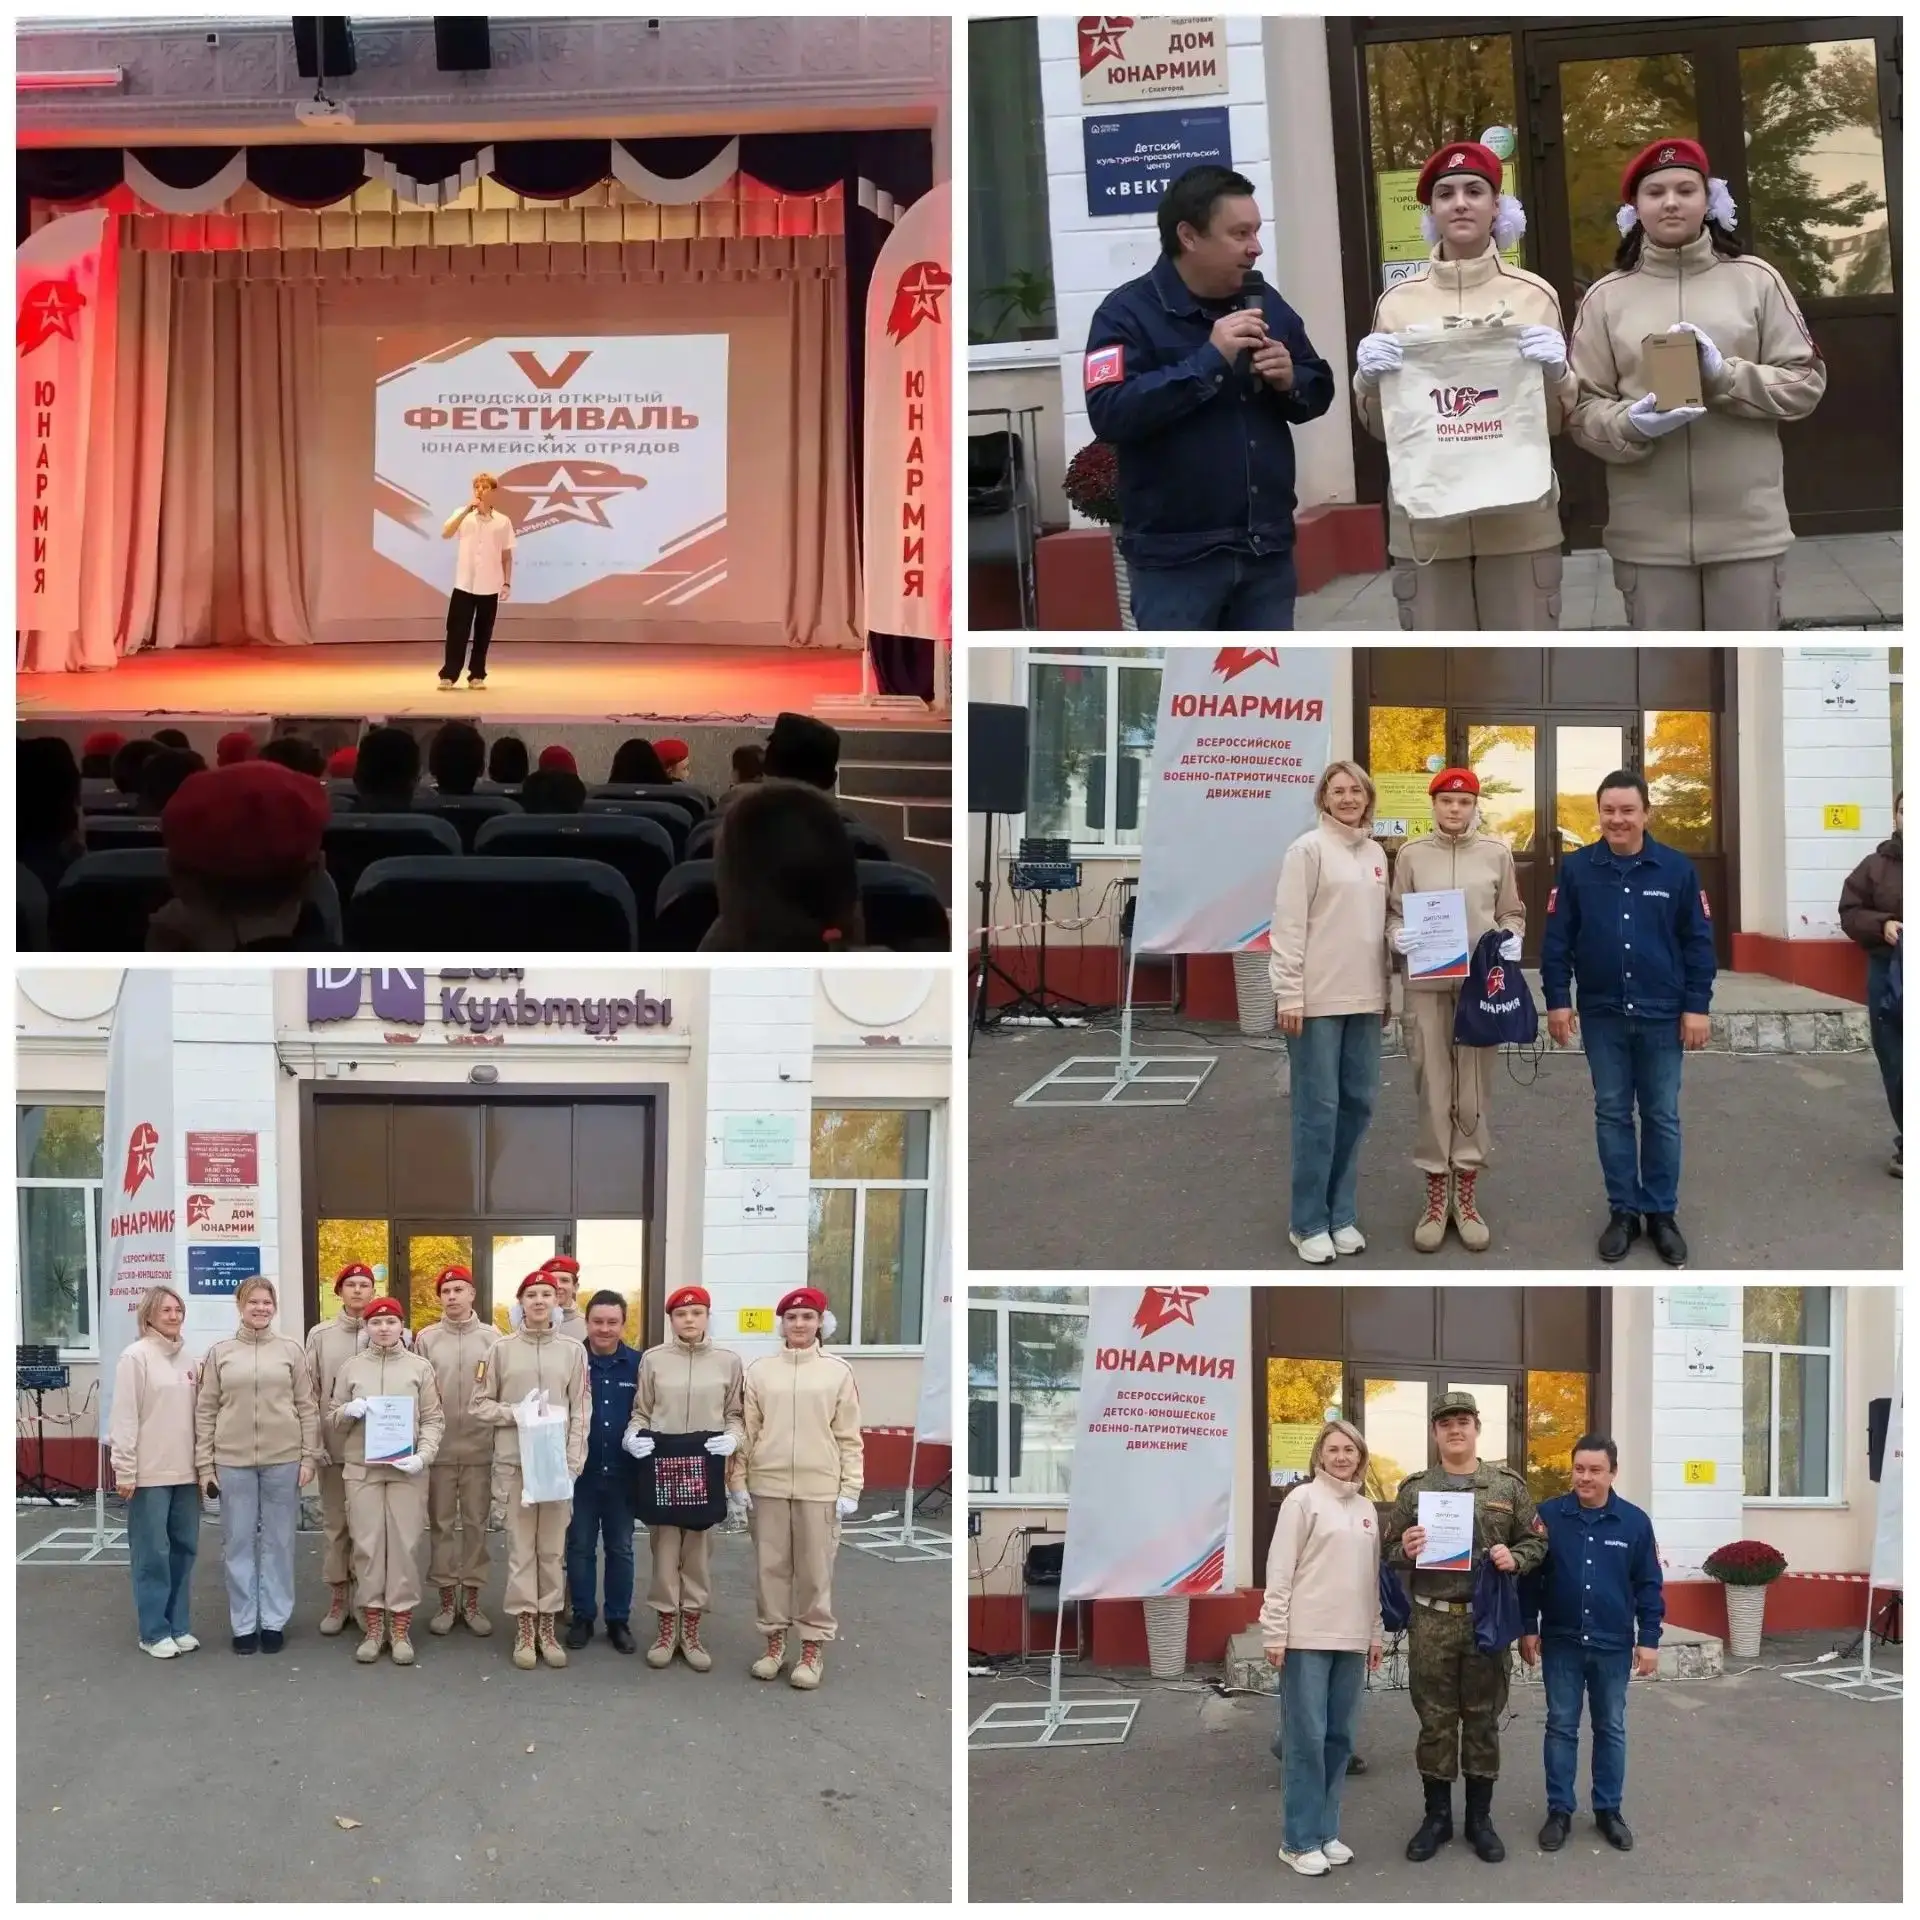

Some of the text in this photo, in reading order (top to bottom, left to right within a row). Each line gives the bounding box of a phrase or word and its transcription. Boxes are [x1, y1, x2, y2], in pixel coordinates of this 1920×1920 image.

[1168, 31, 1214, 54] ДОМ
[1108, 59, 1216, 85] ЮНАРМИИ
[1134, 139, 1181, 153] Детский
[1096, 148, 1220, 166] культурно-просветительский
[1146, 162, 1171, 171] центр
[1105, 179, 1170, 196] «ВЕКТ
[507, 350, 594, 390] V
[437, 391, 664, 406] ГОРОДСКОЙ ОТКРЫТЫЙ
[403, 406, 700, 431] ФЕСТИВАЛЬ
[1436, 419, 1502, 435] ЮНАРМИЯ
[421, 439, 681, 456] ЮНАРМЕЙСКИХ ОТРЯДОВ
[33, 380, 56, 595] ЮНАРМИЯ
[902, 369, 925, 599] ЮНАРМИЯ
[514, 516, 560, 536] АРМИЯ
[1171, 694, 1324, 722] ЮНАРМИЯ
[1196, 736, 1292, 750] ВСЕРОССИЙСКОЕ
[1180, 754, 1303, 767] ДЕТСКО-ЮНОШЕСКОЕ
[1163, 771, 1316, 784] ВОЕННО-ПАТРИОТИЧЕСКОЕ
[1206, 787, 1272, 799] ДВИЖЕНИЕ
[440, 986, 673, 1034] Культуры
[1479, 997, 1521, 1014] ЮНАРМИЯ
[231, 1209, 254, 1219] ДОМ
[110, 1210, 175, 1238] ЮНАРМИЯ
[201, 1223, 255, 1232] ЮНАРМИИ
[198, 1278, 242, 1287] «ВЕКТО
[1095, 1347, 1235, 1380] ЮНАРМИЯ
[1117, 1391, 1206, 1404] ВСЕРОССИЙСКОЕ
[1103, 1407, 1216, 1421] ДЕТСКО-ЮНОШЕСКОЕ
[1088, 1423, 1228, 1437] ВОЕННО-ПАТРИОТИЧЕСКОЕ
[1126, 1440, 1188, 1451] ДВИЖЕНИЕ
